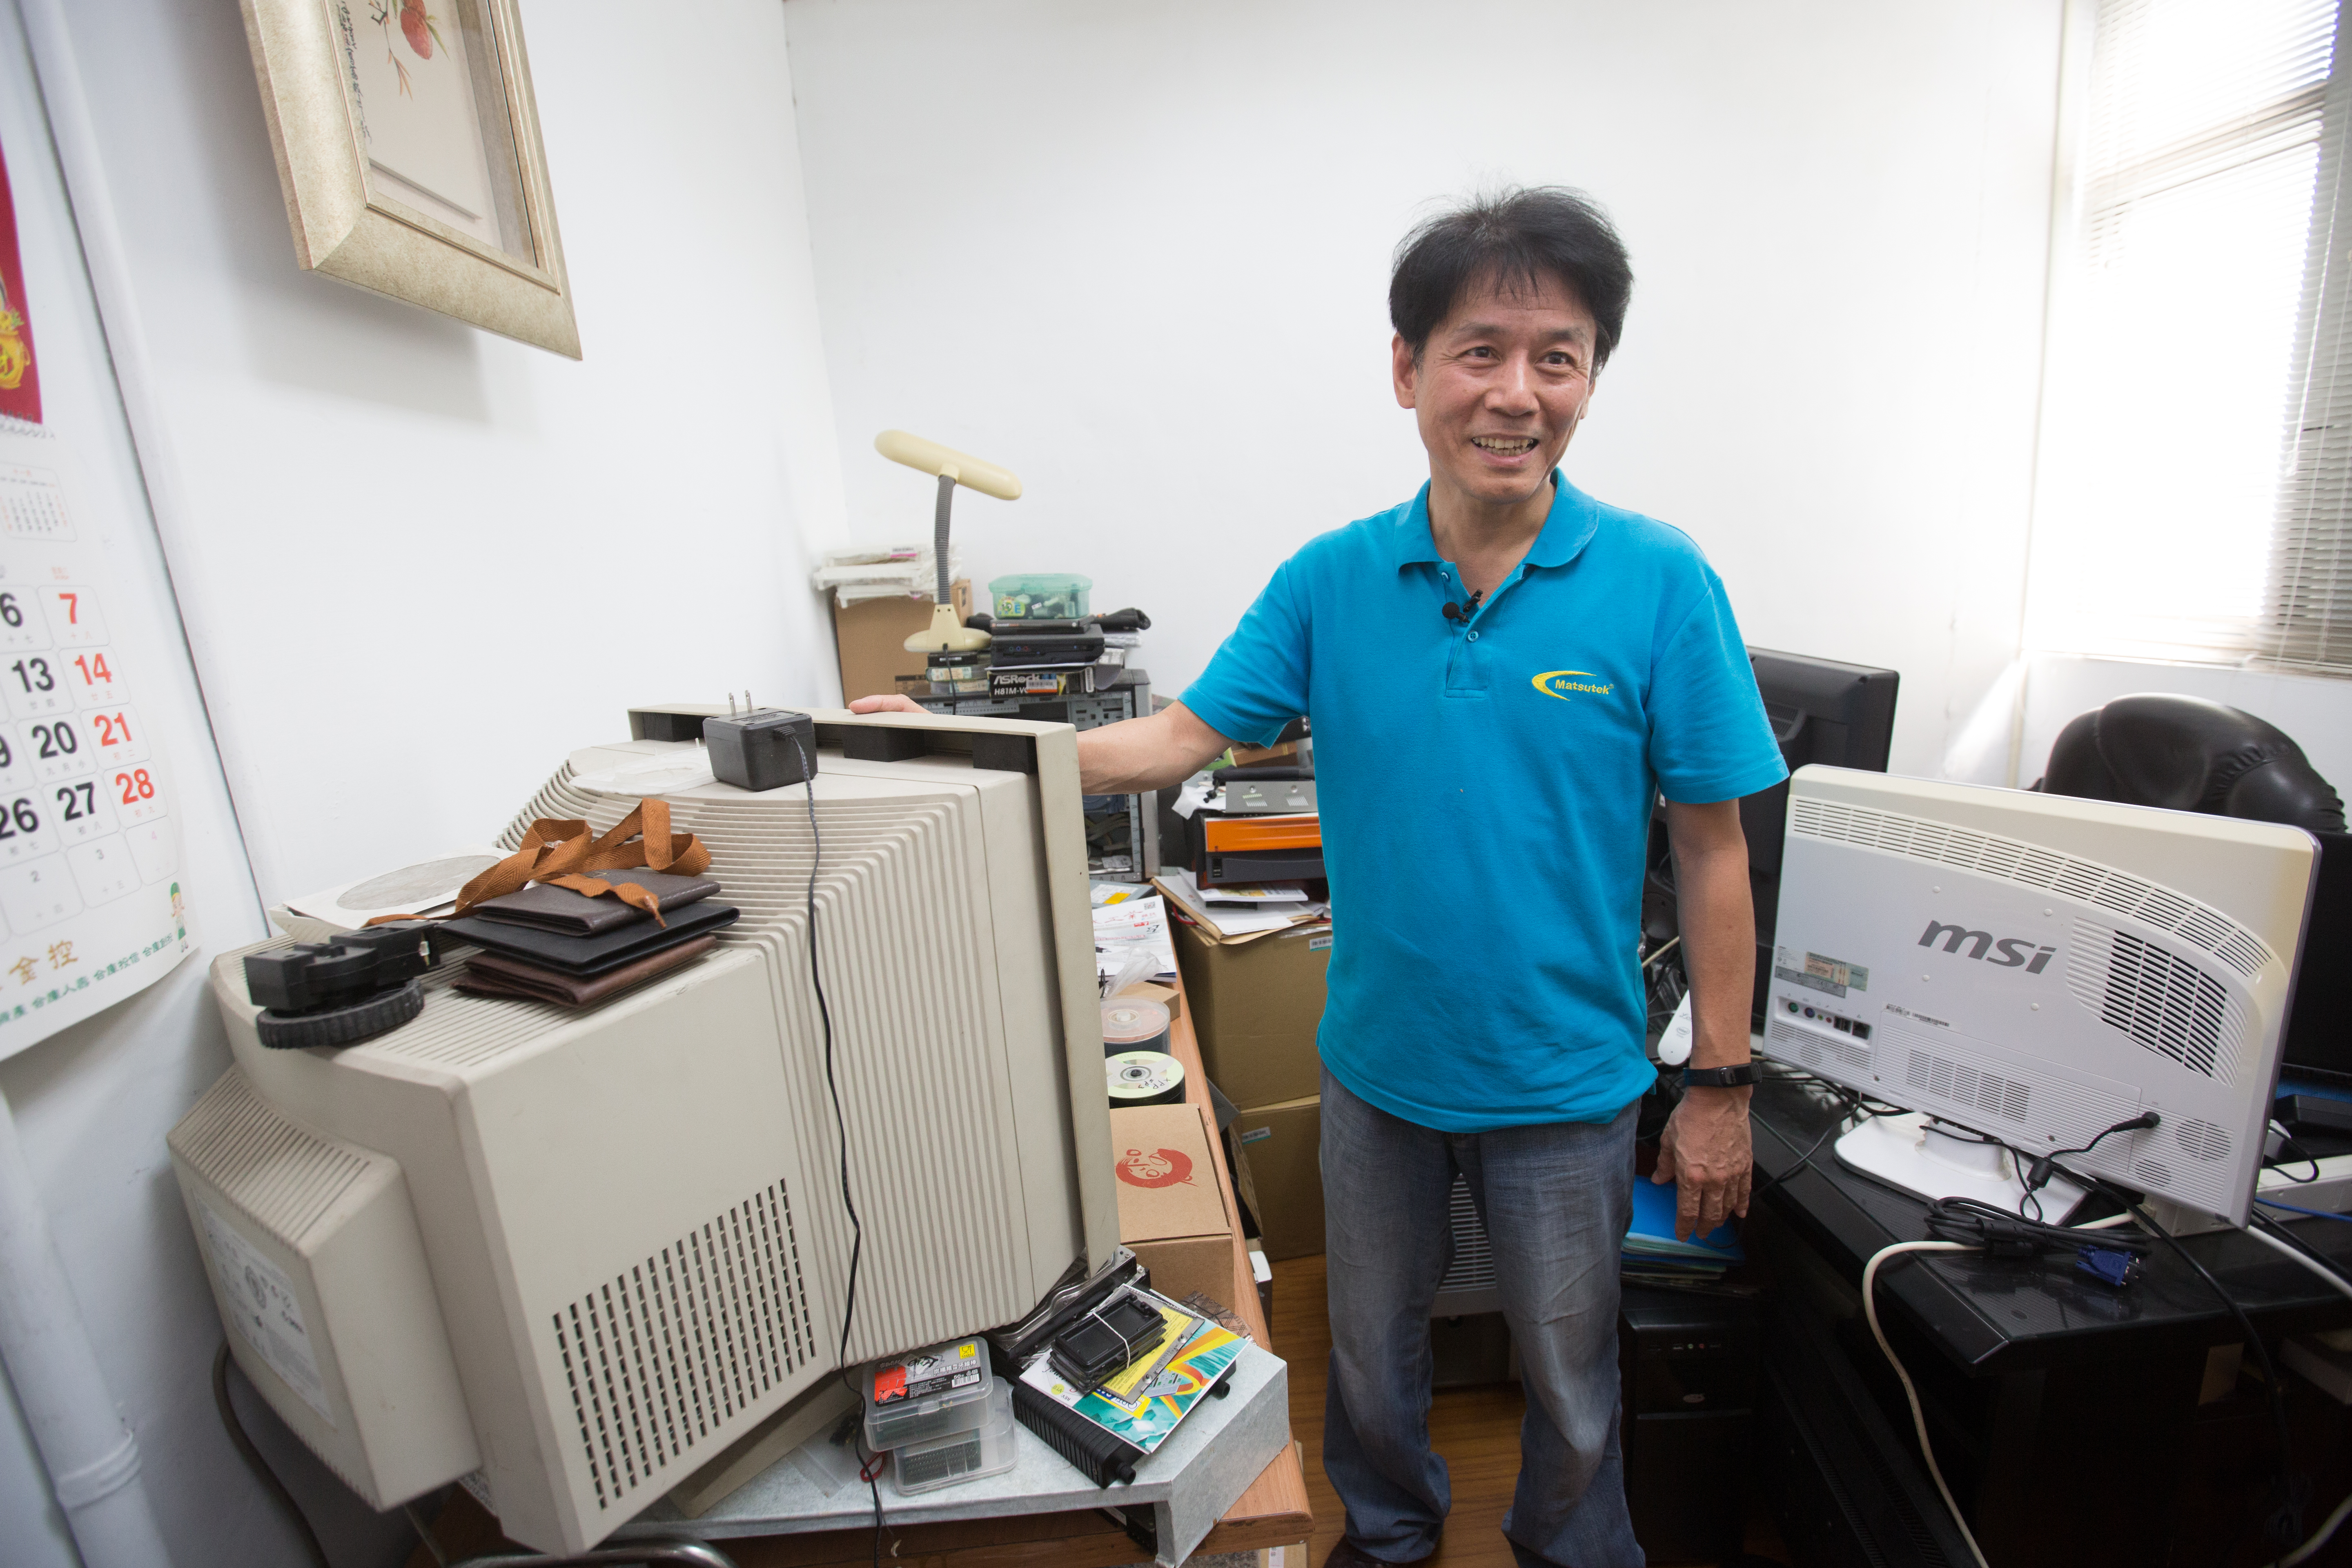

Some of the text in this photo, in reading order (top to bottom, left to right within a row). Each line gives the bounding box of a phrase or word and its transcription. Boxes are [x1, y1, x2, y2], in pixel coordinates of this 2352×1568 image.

[0, 592, 78, 628] 6 7
[11, 653, 112, 693] 13 14
[993, 675, 1040, 685] ASRock
[1555, 679, 1609, 695] Matsutek
[32, 721, 78, 759] 20
[94, 712, 132, 747] 21
[57, 782, 96, 822] 27
[116, 768, 155, 805] 28
[31, 830, 157, 883] 2 3 4
[0, 940, 79, 991] 金控
[1918, 920, 2057, 974] msi
